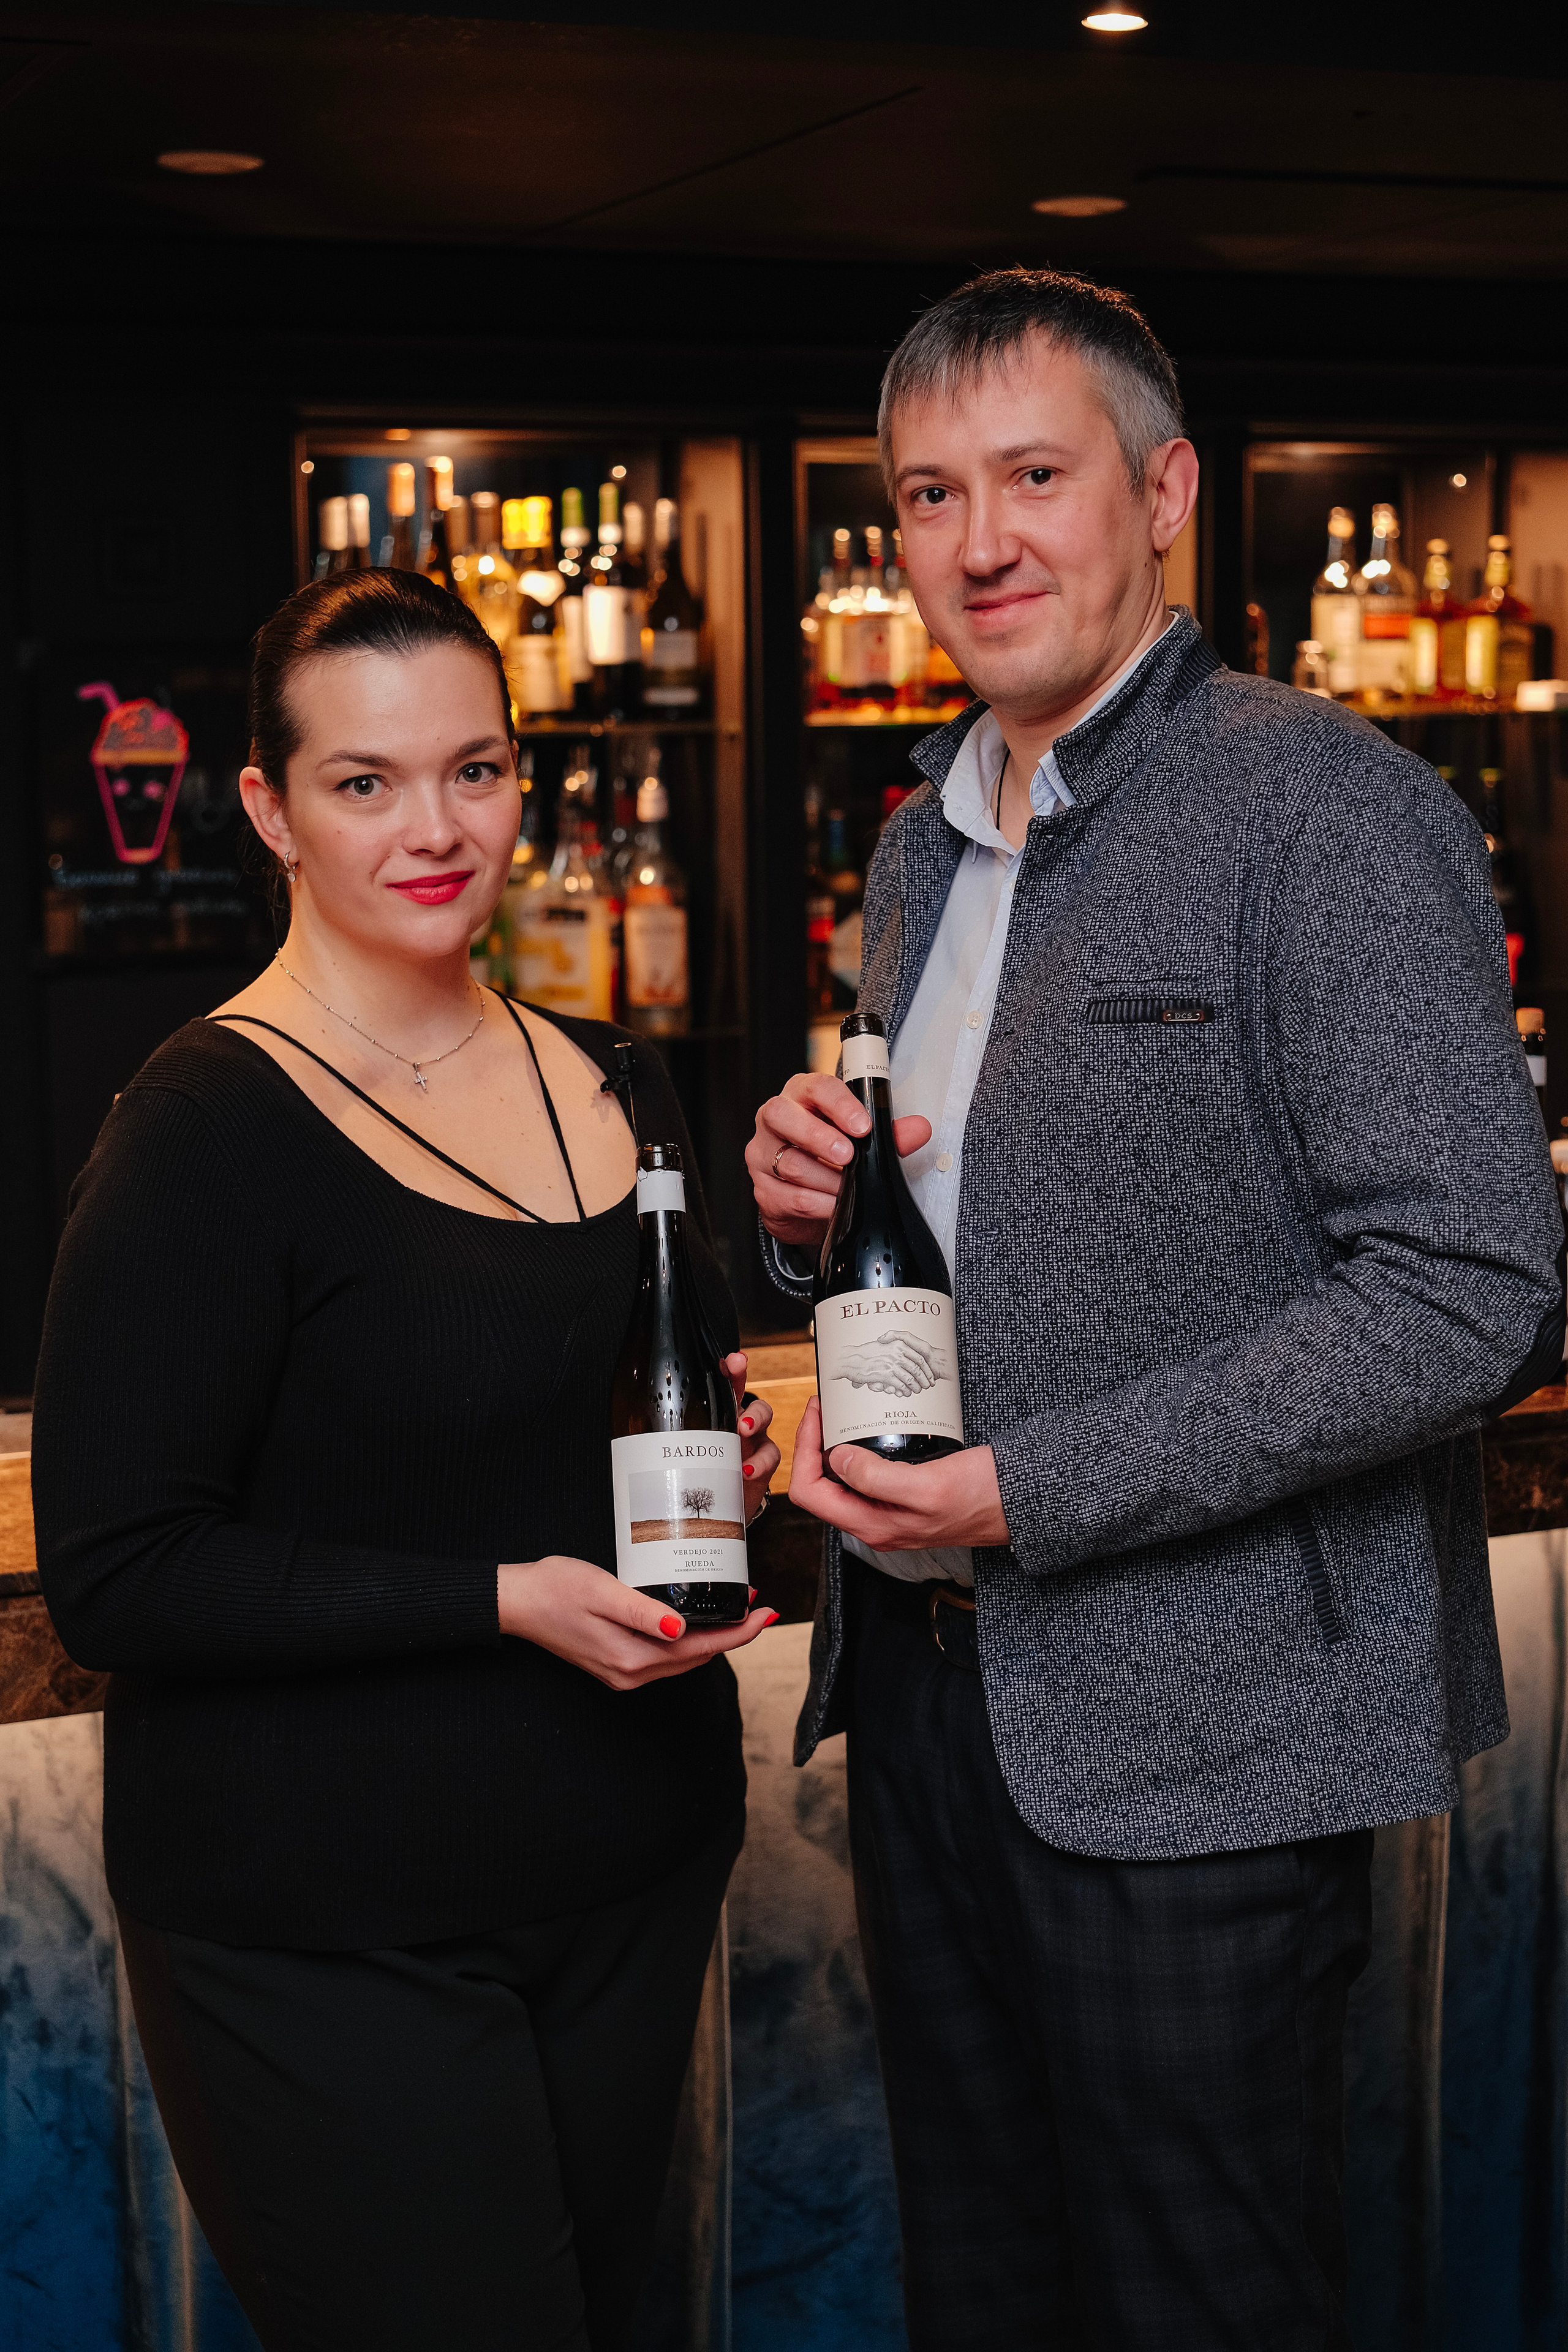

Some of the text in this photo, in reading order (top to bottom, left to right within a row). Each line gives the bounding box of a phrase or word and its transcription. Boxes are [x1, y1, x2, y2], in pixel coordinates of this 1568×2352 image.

[840, 1299, 941, 1320] EL PACTO
[884, 1410, 918, 1419] RIOJA
[840, 1420, 887, 1434] DENOMINACIÓN
[926, 1420, 956, 1430] CALIFICADA
[662, 1445, 725, 1458] BARDOS
